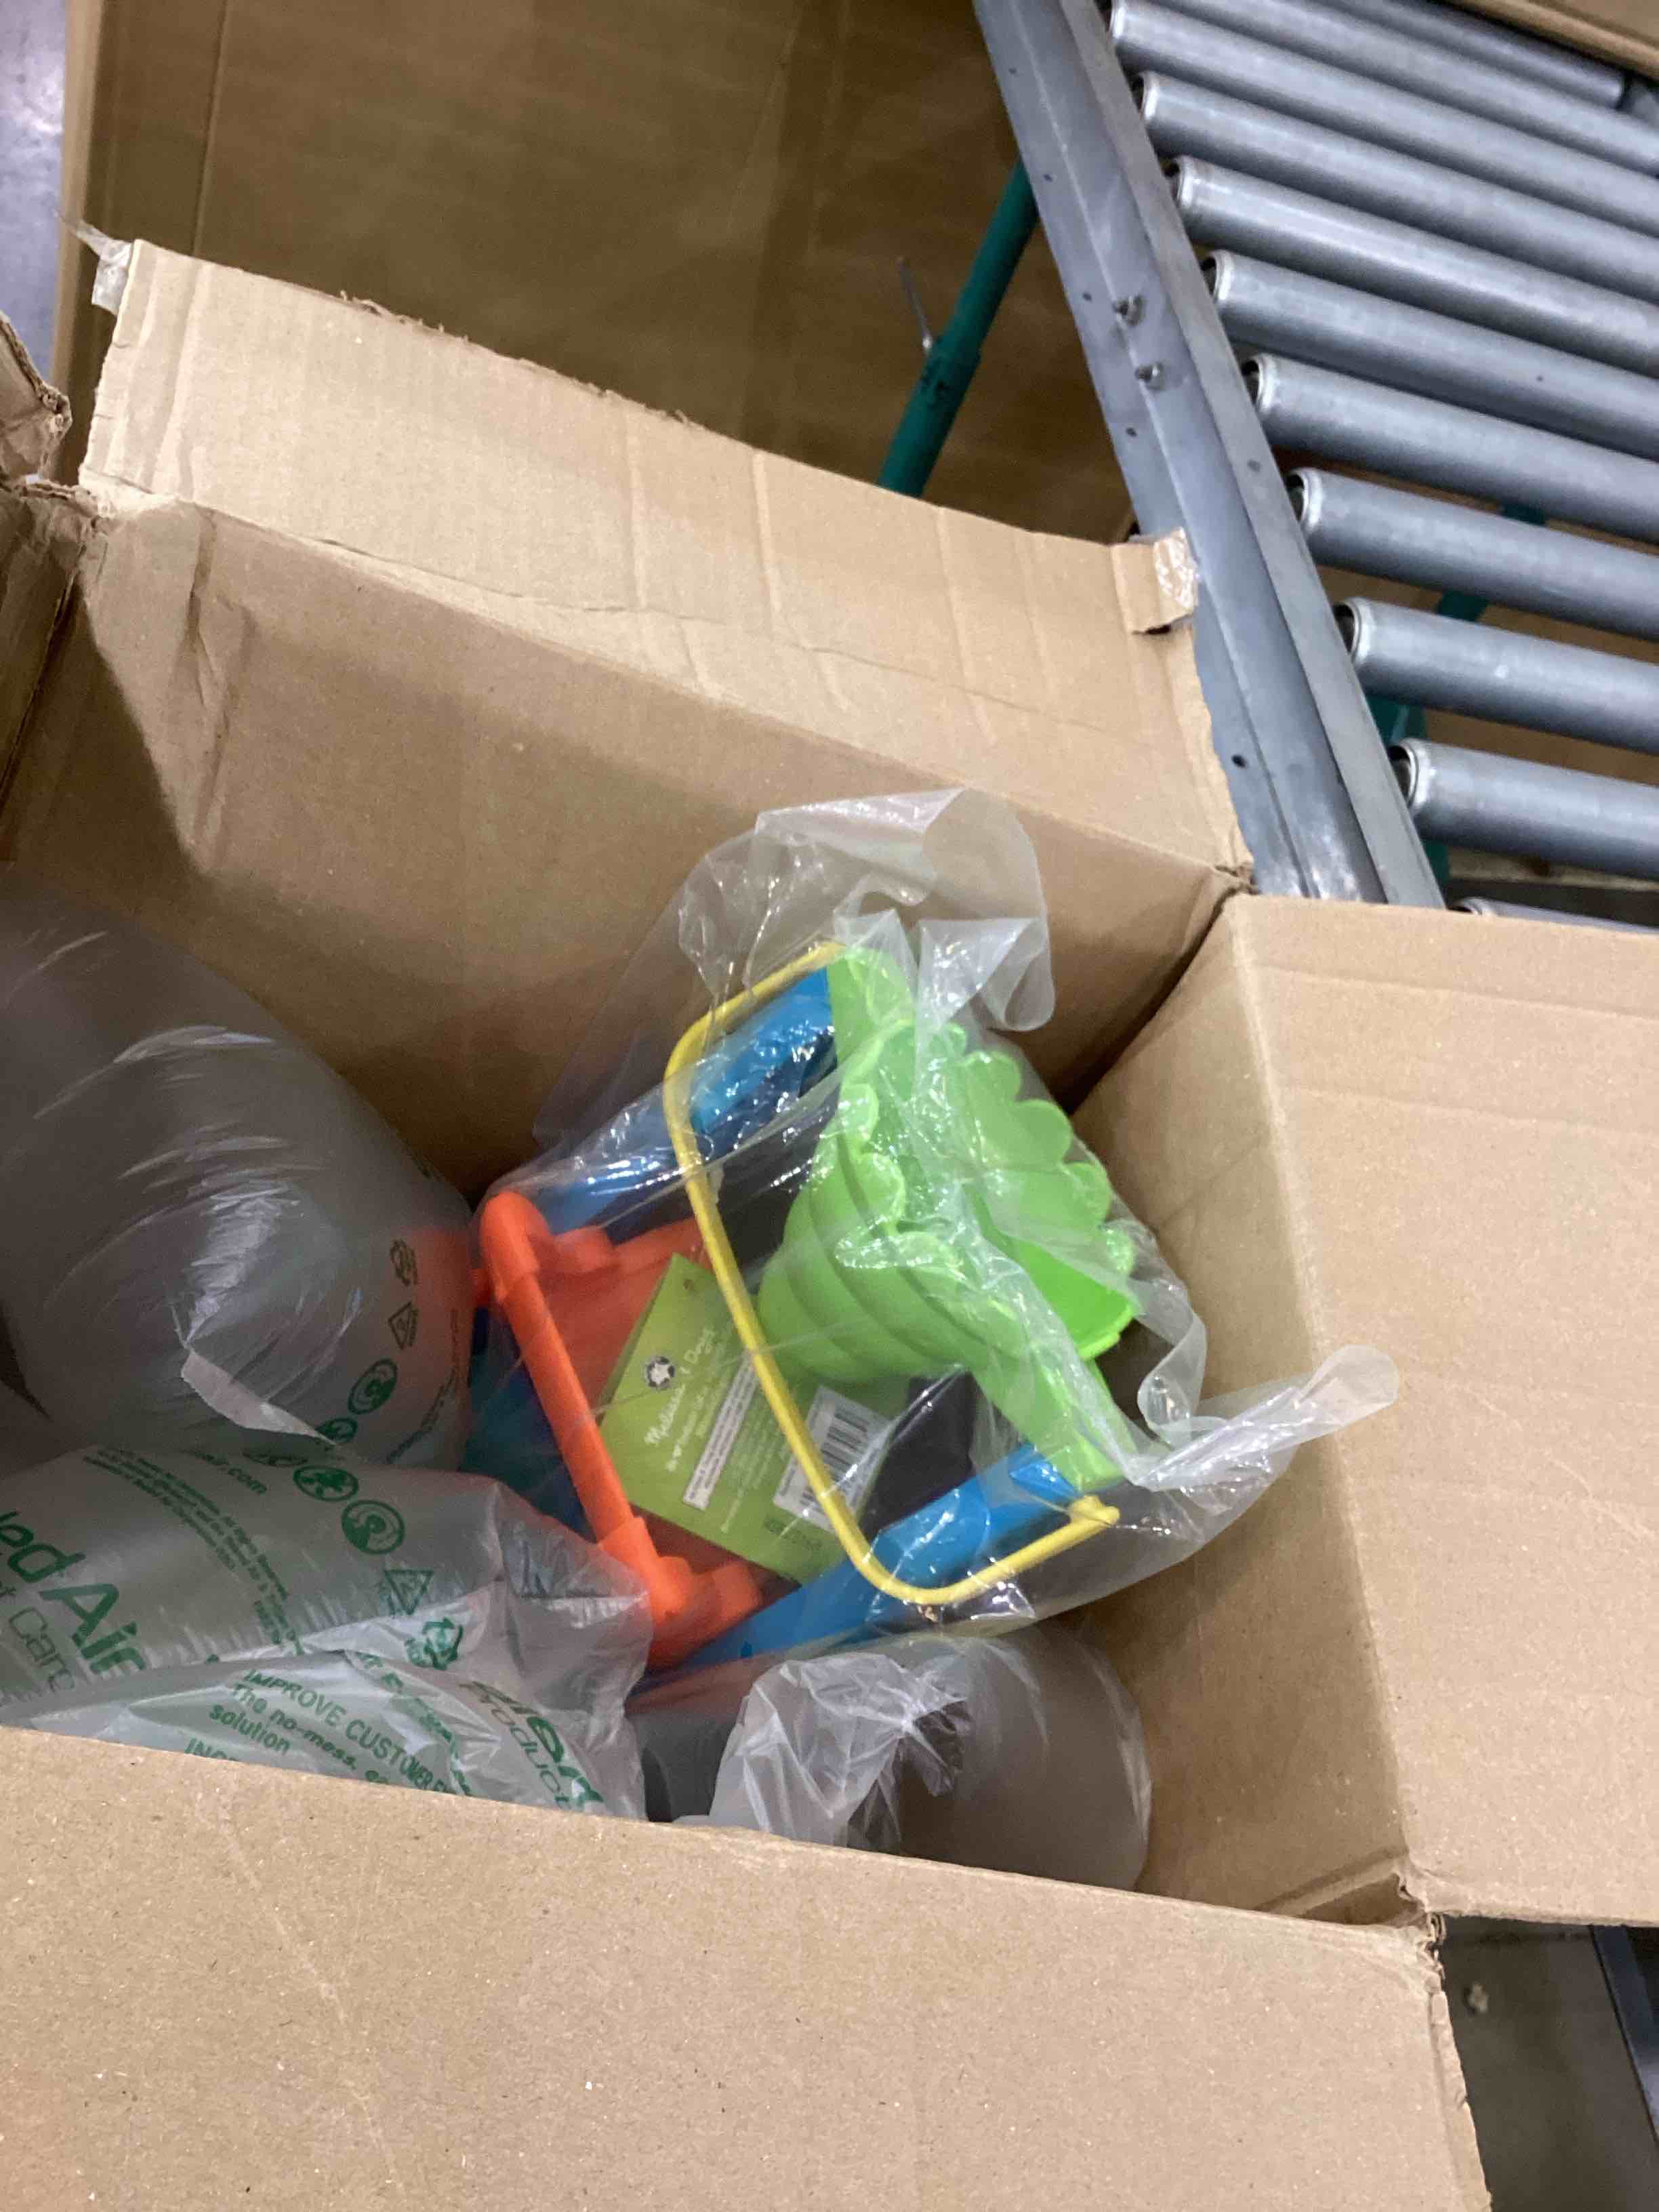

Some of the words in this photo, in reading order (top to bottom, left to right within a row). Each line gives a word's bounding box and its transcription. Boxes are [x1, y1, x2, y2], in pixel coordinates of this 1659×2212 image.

[38, 1582, 146, 1678] Air
[243, 1668, 346, 1727] IMPROVE
[209, 1704, 291, 1756] solution
